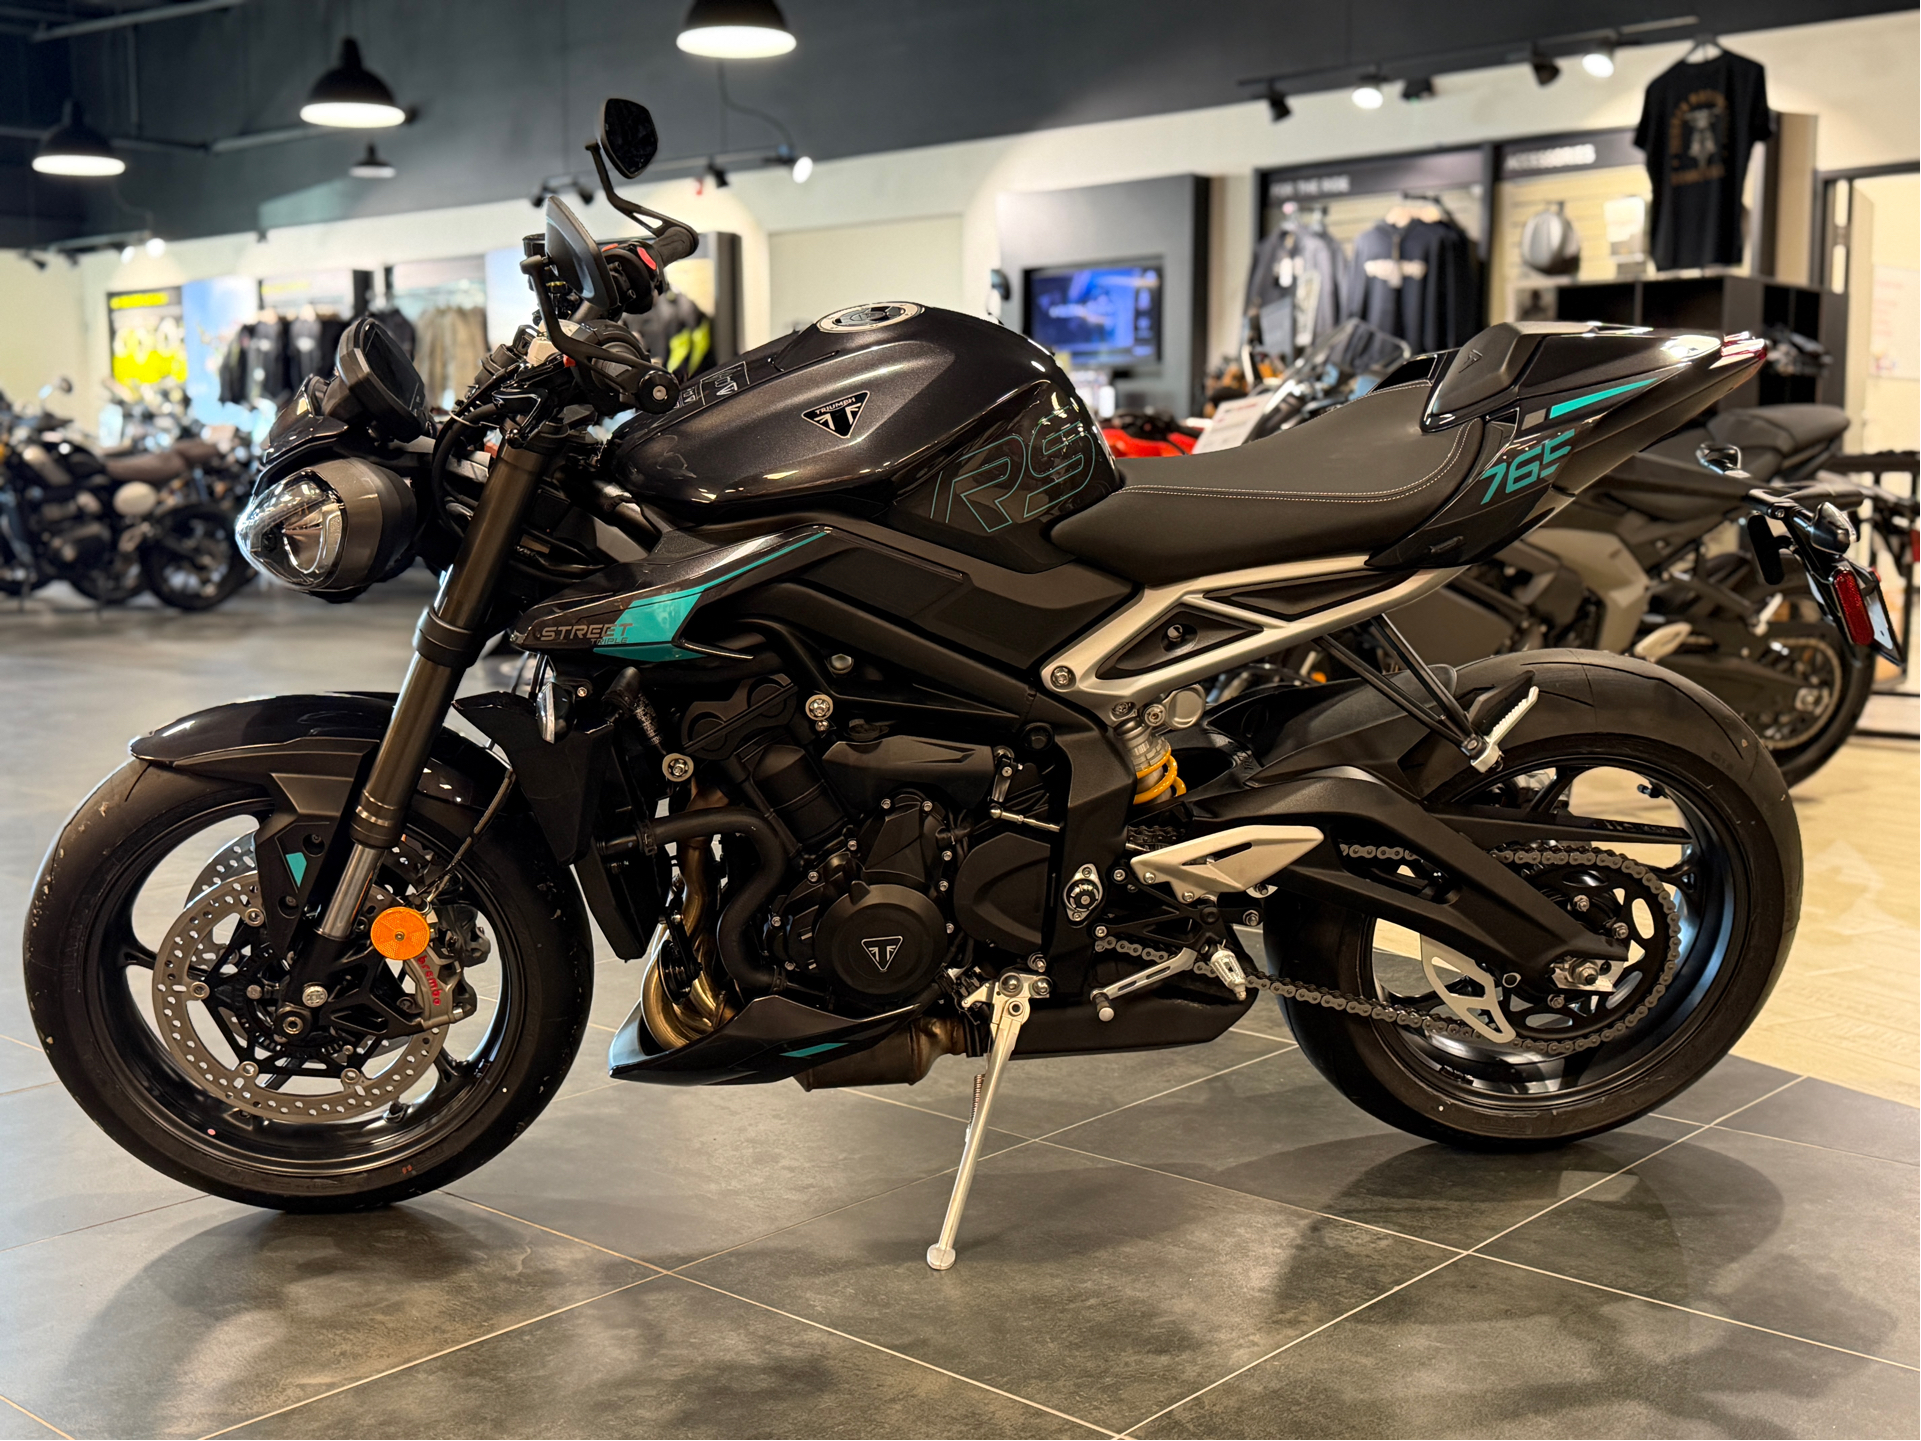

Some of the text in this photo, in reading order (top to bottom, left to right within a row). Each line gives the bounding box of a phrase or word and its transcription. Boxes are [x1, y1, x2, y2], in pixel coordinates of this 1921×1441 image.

[815, 397, 856, 415] TRIUMPH
[930, 405, 1096, 533] RS
[1480, 428, 1575, 505] 765
[540, 623, 633, 641] STREET
[591, 637, 629, 645] TRIPLE
[417, 954, 443, 1006] brembo
